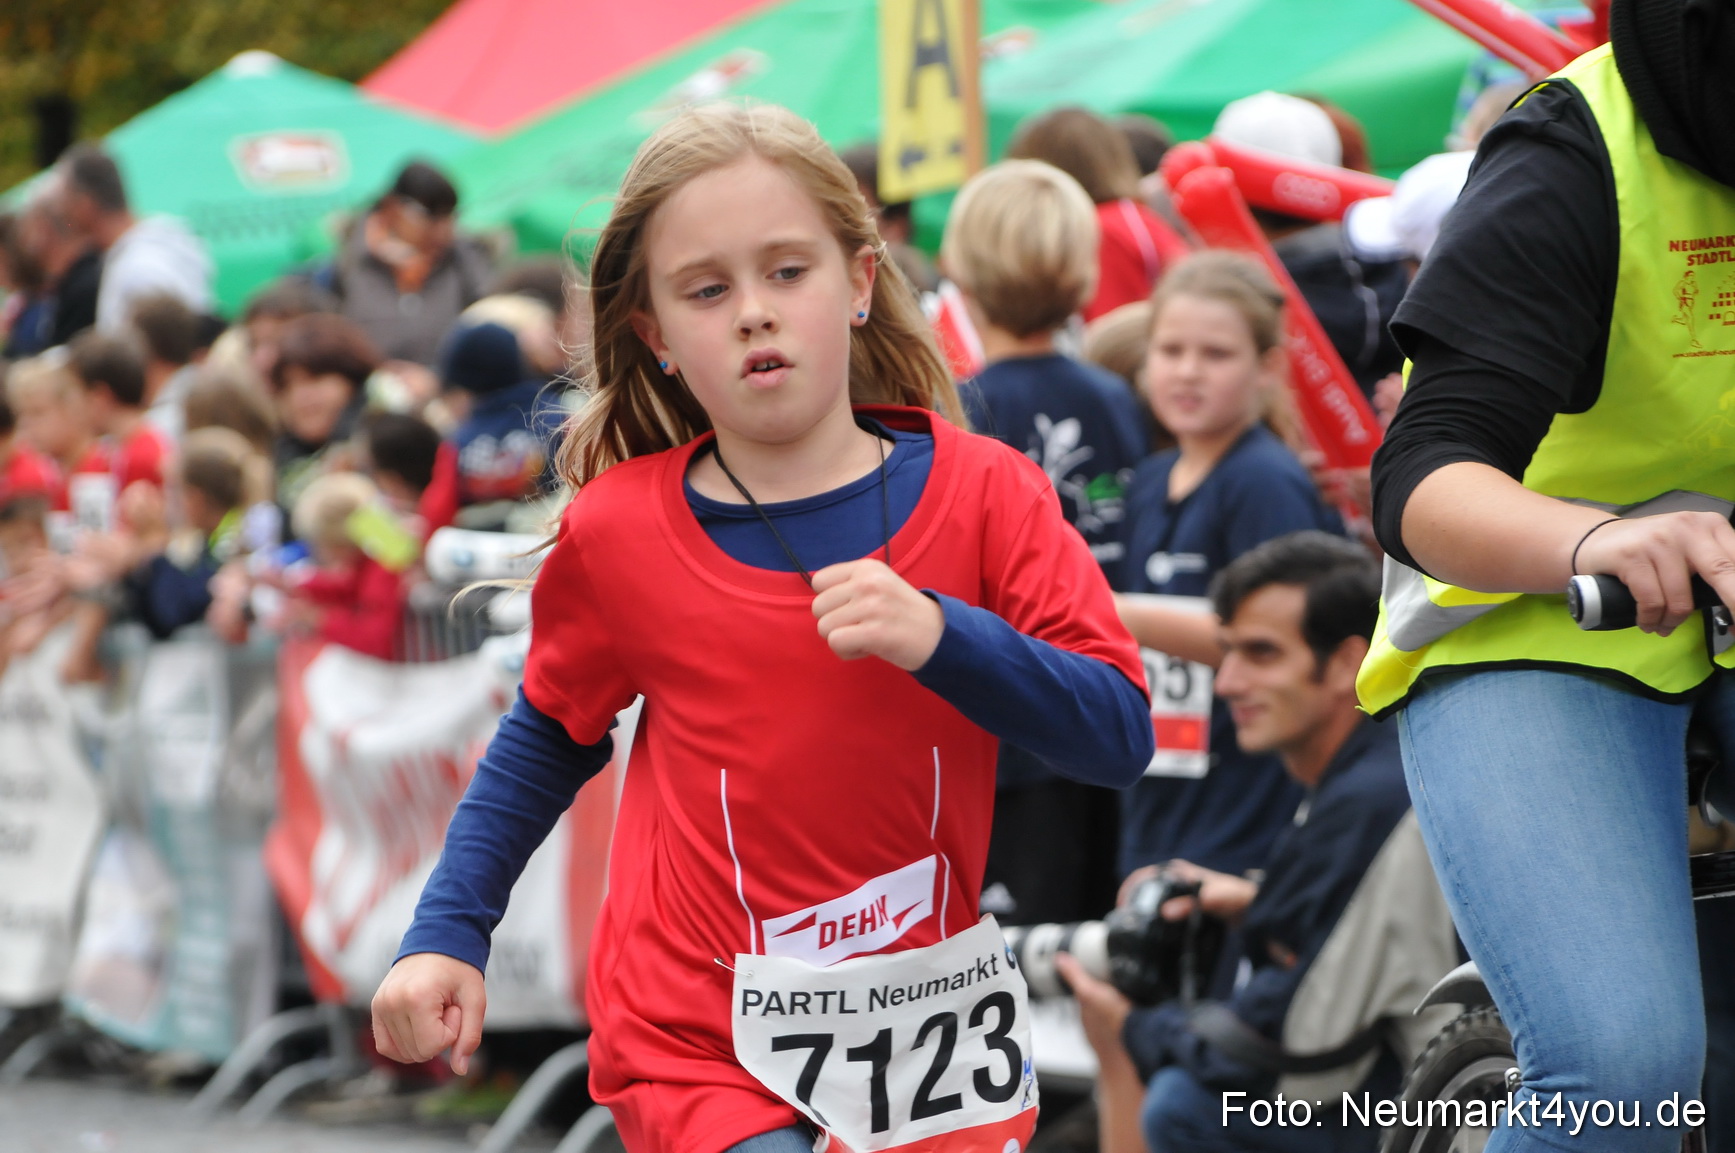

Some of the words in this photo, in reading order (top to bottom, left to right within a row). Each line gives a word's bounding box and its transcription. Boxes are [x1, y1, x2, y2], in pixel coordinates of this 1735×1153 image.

[741, 989, 858, 1017] PARTL
[868, 953, 1000, 1013] Neumarkt
[771, 990, 1023, 1135] 7123
